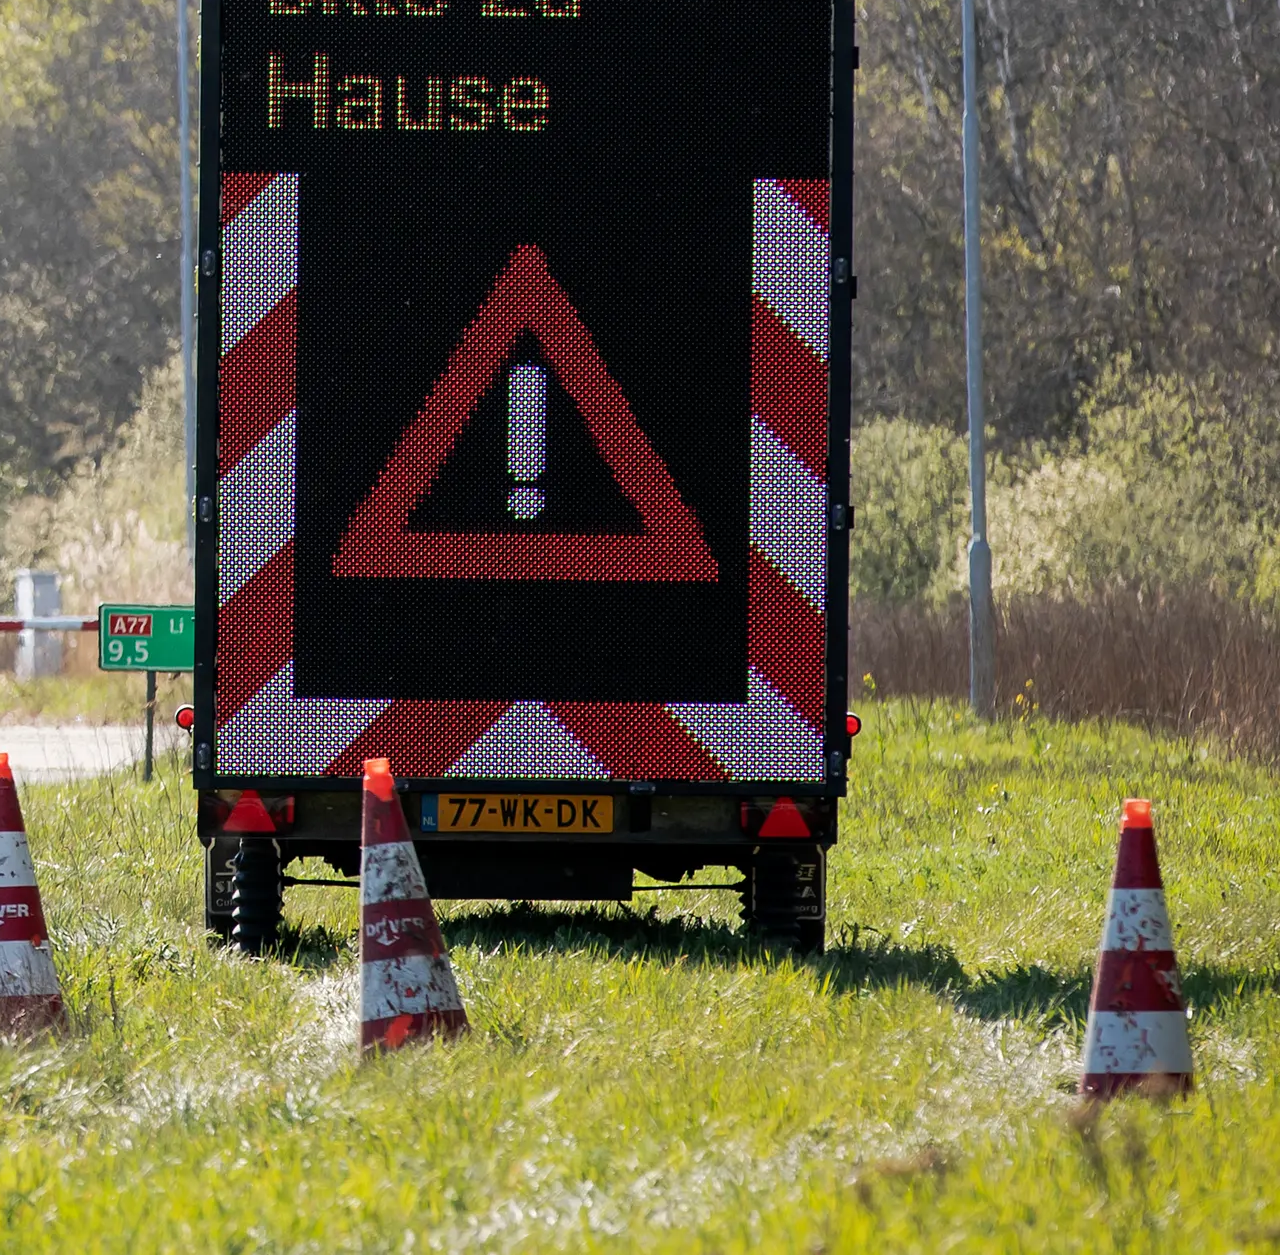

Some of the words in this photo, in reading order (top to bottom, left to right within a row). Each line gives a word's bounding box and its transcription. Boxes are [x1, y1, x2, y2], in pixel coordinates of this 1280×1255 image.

[268, 52, 550, 132] Hause
[113, 616, 149, 634] A77
[169, 617, 184, 635] Li
[108, 639, 149, 665] 9,5
[422, 816, 437, 827] NL
[448, 797, 601, 828] 77-WK-DK
